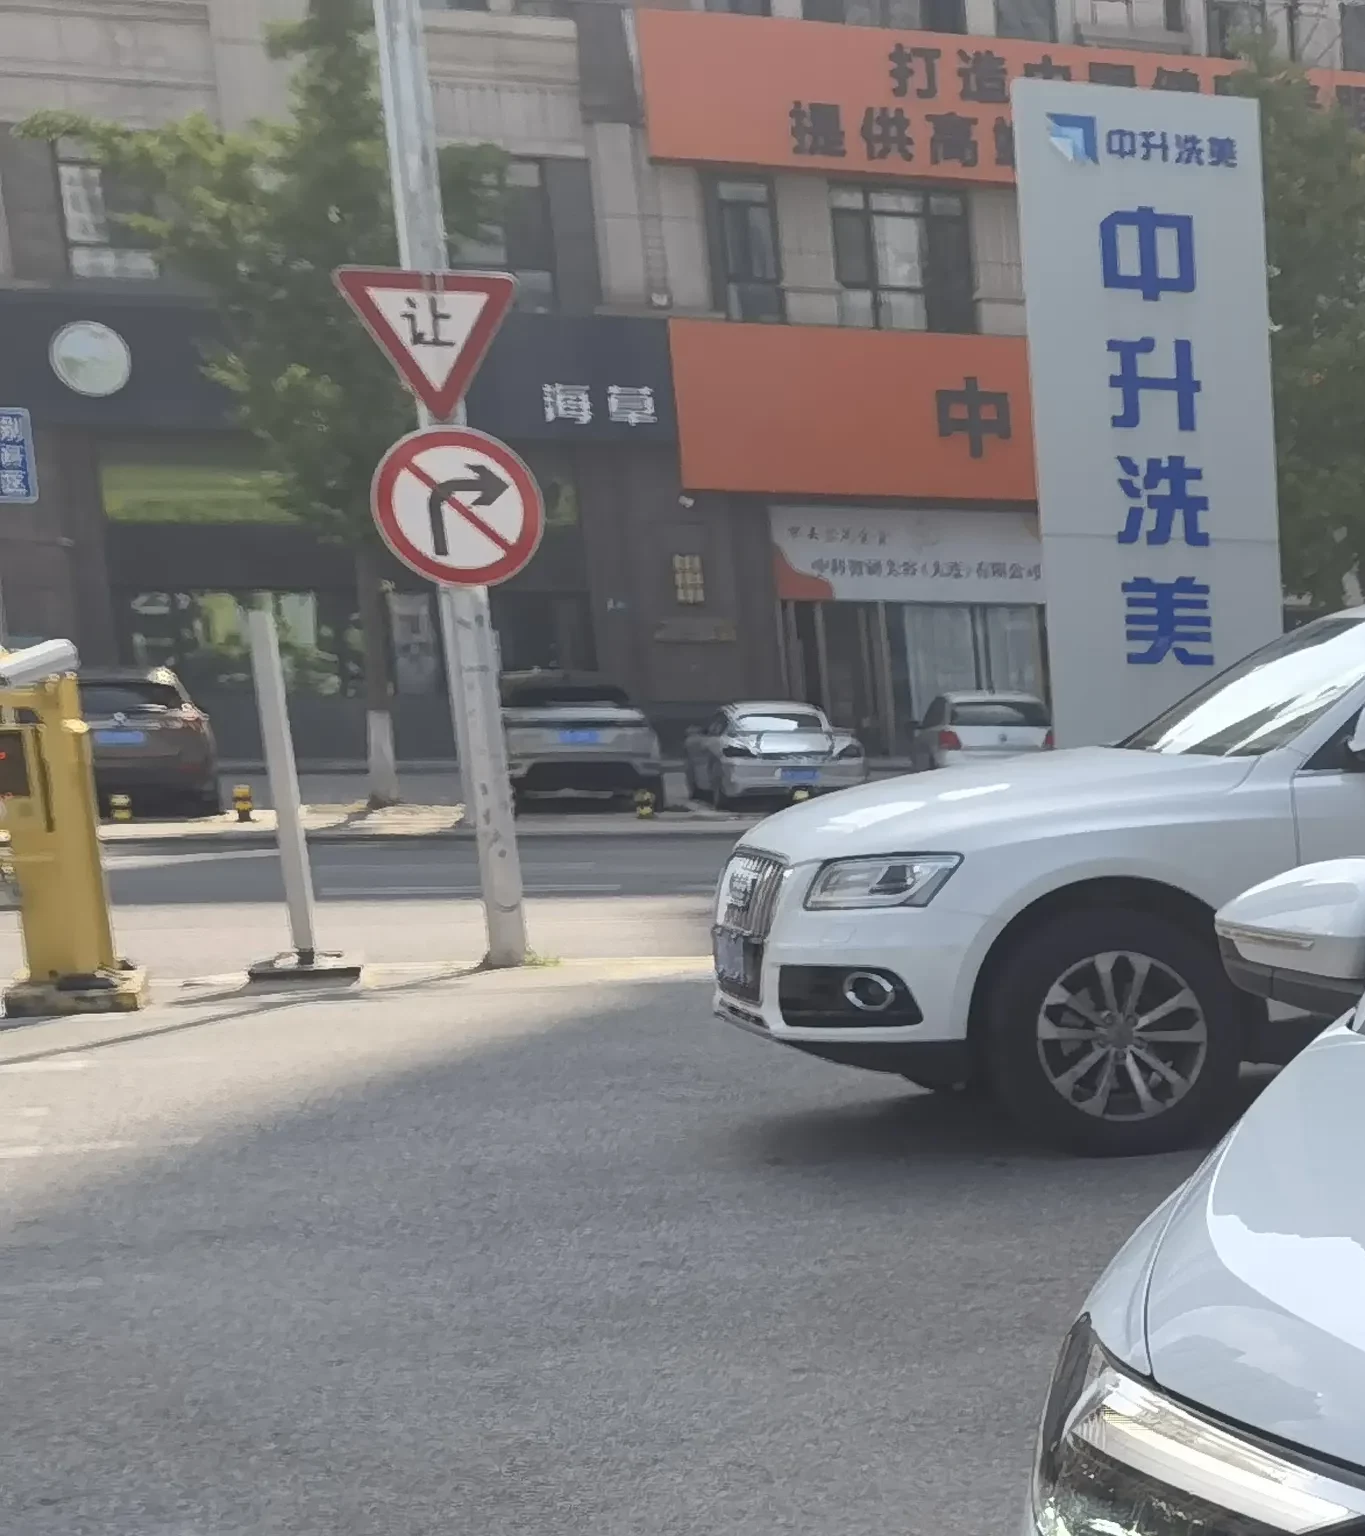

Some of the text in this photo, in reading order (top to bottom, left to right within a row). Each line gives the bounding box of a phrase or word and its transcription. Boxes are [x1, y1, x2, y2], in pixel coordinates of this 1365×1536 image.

[1106, 129, 1238, 168] 中升洗美
[401, 297, 455, 346] 让
[935, 376, 1011, 458] 中
[1100, 206, 1214, 666] 中升洗美
